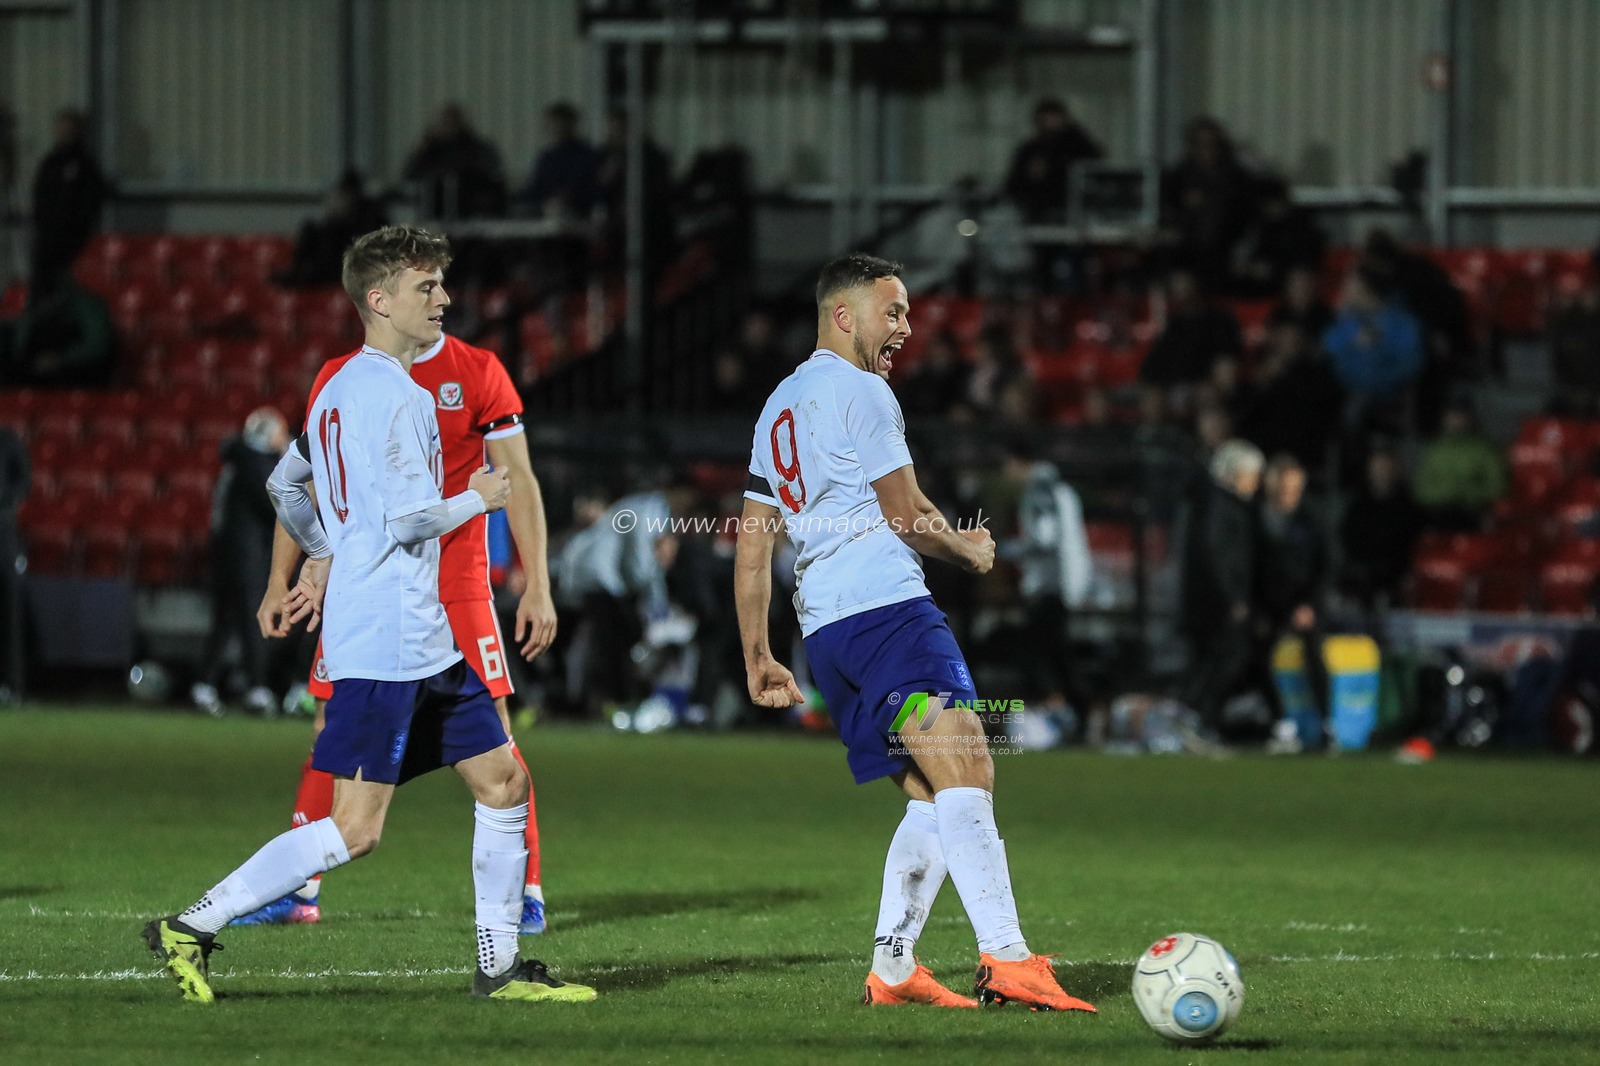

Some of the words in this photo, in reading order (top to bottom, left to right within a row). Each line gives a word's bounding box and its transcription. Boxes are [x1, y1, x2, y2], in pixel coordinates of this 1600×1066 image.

[319, 407, 349, 524] 10
[770, 407, 806, 514] 9
[477, 635, 504, 682] 6
